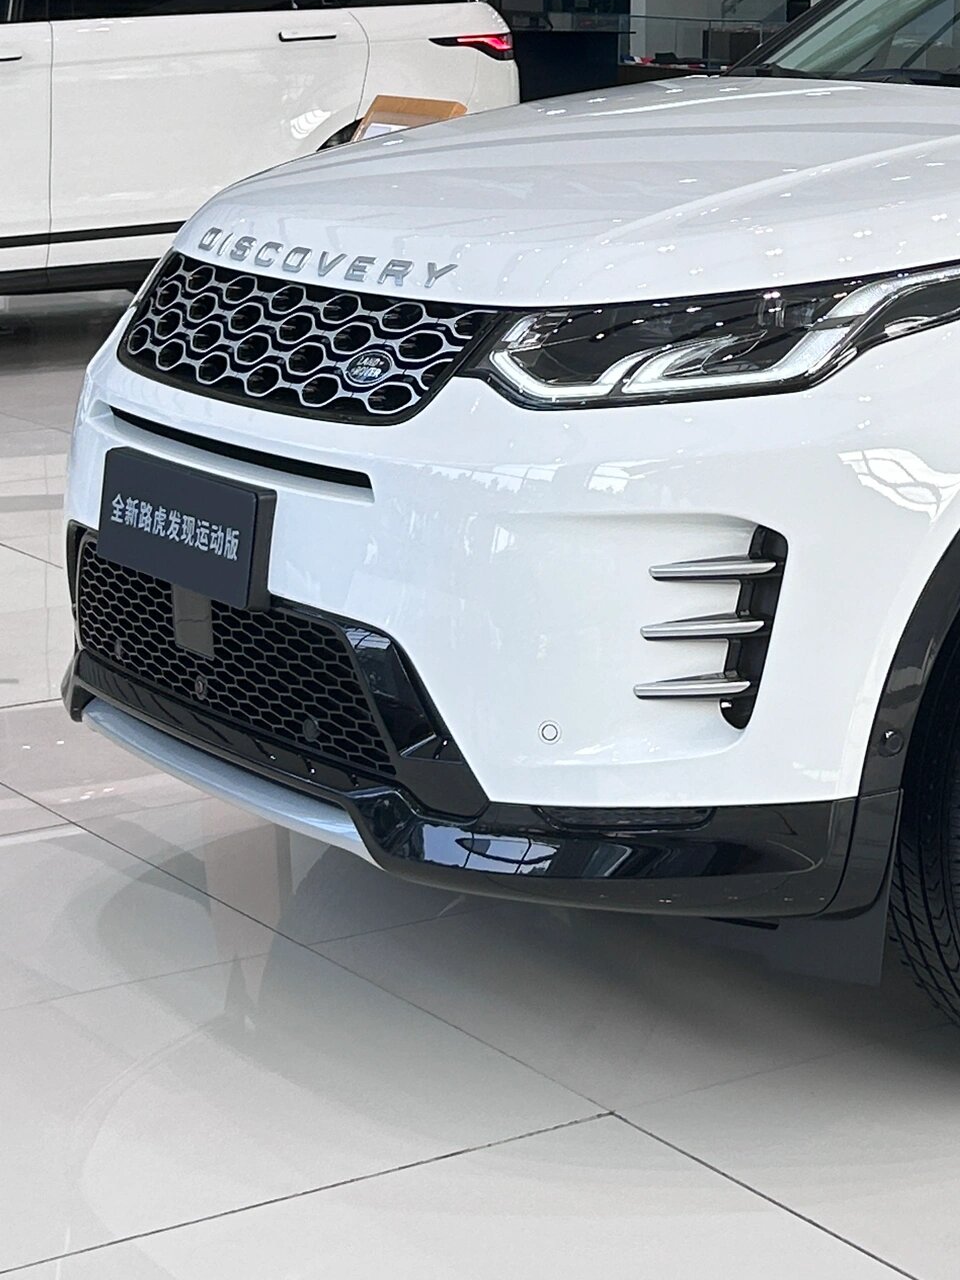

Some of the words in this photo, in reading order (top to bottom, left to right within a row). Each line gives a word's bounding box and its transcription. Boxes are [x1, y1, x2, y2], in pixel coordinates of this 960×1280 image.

[198, 227, 459, 289] DISCOVERY
[110, 493, 240, 561] 全新路虎发现运动版
